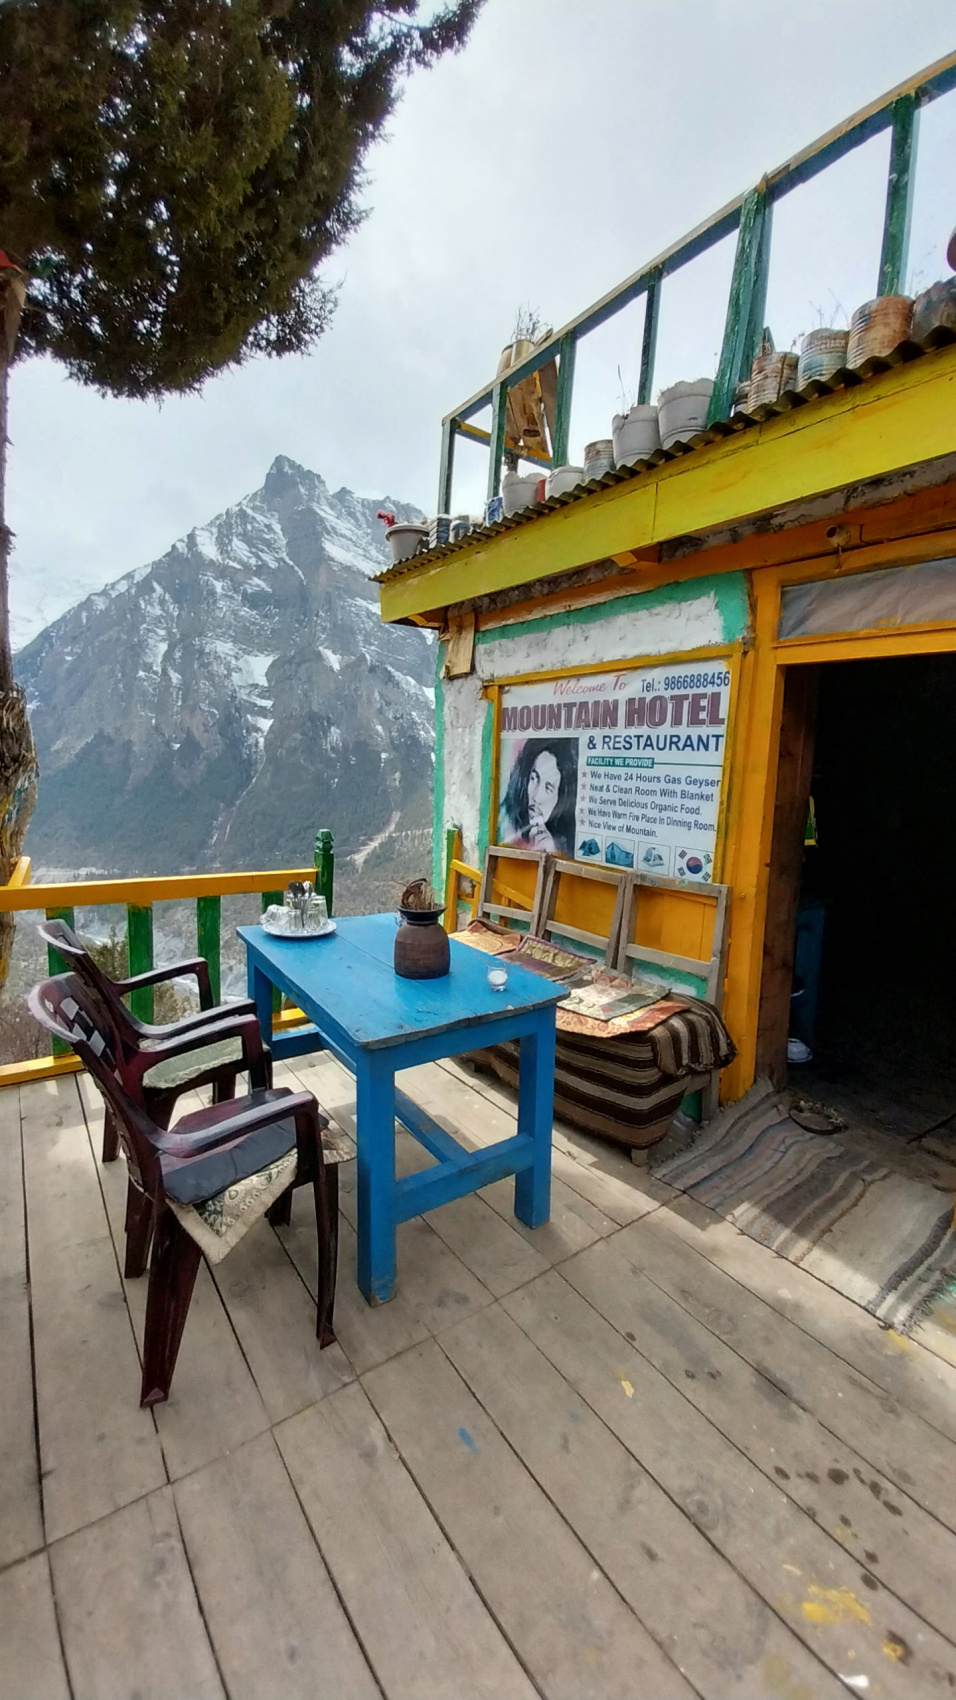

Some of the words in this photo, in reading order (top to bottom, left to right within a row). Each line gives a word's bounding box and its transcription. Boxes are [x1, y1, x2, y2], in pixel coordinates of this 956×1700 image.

[553, 678, 608, 696] Welcome
[612, 673, 629, 691] To
[641, 678, 661, 693] Tel.:
[664, 671, 730, 691] 9866888456
[501, 698, 619, 732] MOUNTAIN
[625, 691, 725, 729] HOTEL
[587, 735, 597, 750] &
[602, 734, 724, 752] RESTAURANT
[587, 757, 614, 766] FACILITY
[614, 758, 624, 766] WE
[625, 758, 653, 767] PROVIDE
[590, 770, 602, 780] We
[603, 771, 622, 781] Have
[624, 772, 634, 782] 24
[635, 773, 661, 784] Hours
[664, 774, 682, 785] Gas
[685, 775, 721, 789] Geyser
[589, 783, 604, 793] Neat
[605, 784, 611, 793] &
[612, 784, 633, 795] Clean
[634, 786, 658, 797] Room
[660, 788, 678, 799] With
[680, 789, 714, 802] Blanket
[588, 795, 598, 805] We
[598, 796, 617, 806] Serve
[618, 797, 649, 810] Delicious
[650, 800, 679, 814] Organic
[680, 803, 702, 816] Food.
[587, 807, 597, 817] We
[597, 808, 611, 819] Have
[612, 809, 628, 820] Warm
[628, 811, 640, 822] Fire
[641, 813, 658, 824] Place
[659, 815, 665, 825] In
[666, 816, 692, 830] Dinning
[693, 819, 717, 832] Room.
[588, 819, 602, 829] Nice
[602, 820, 616, 831] View
[617, 823, 625, 833] of
[625, 824, 659, 838] Mountain.
